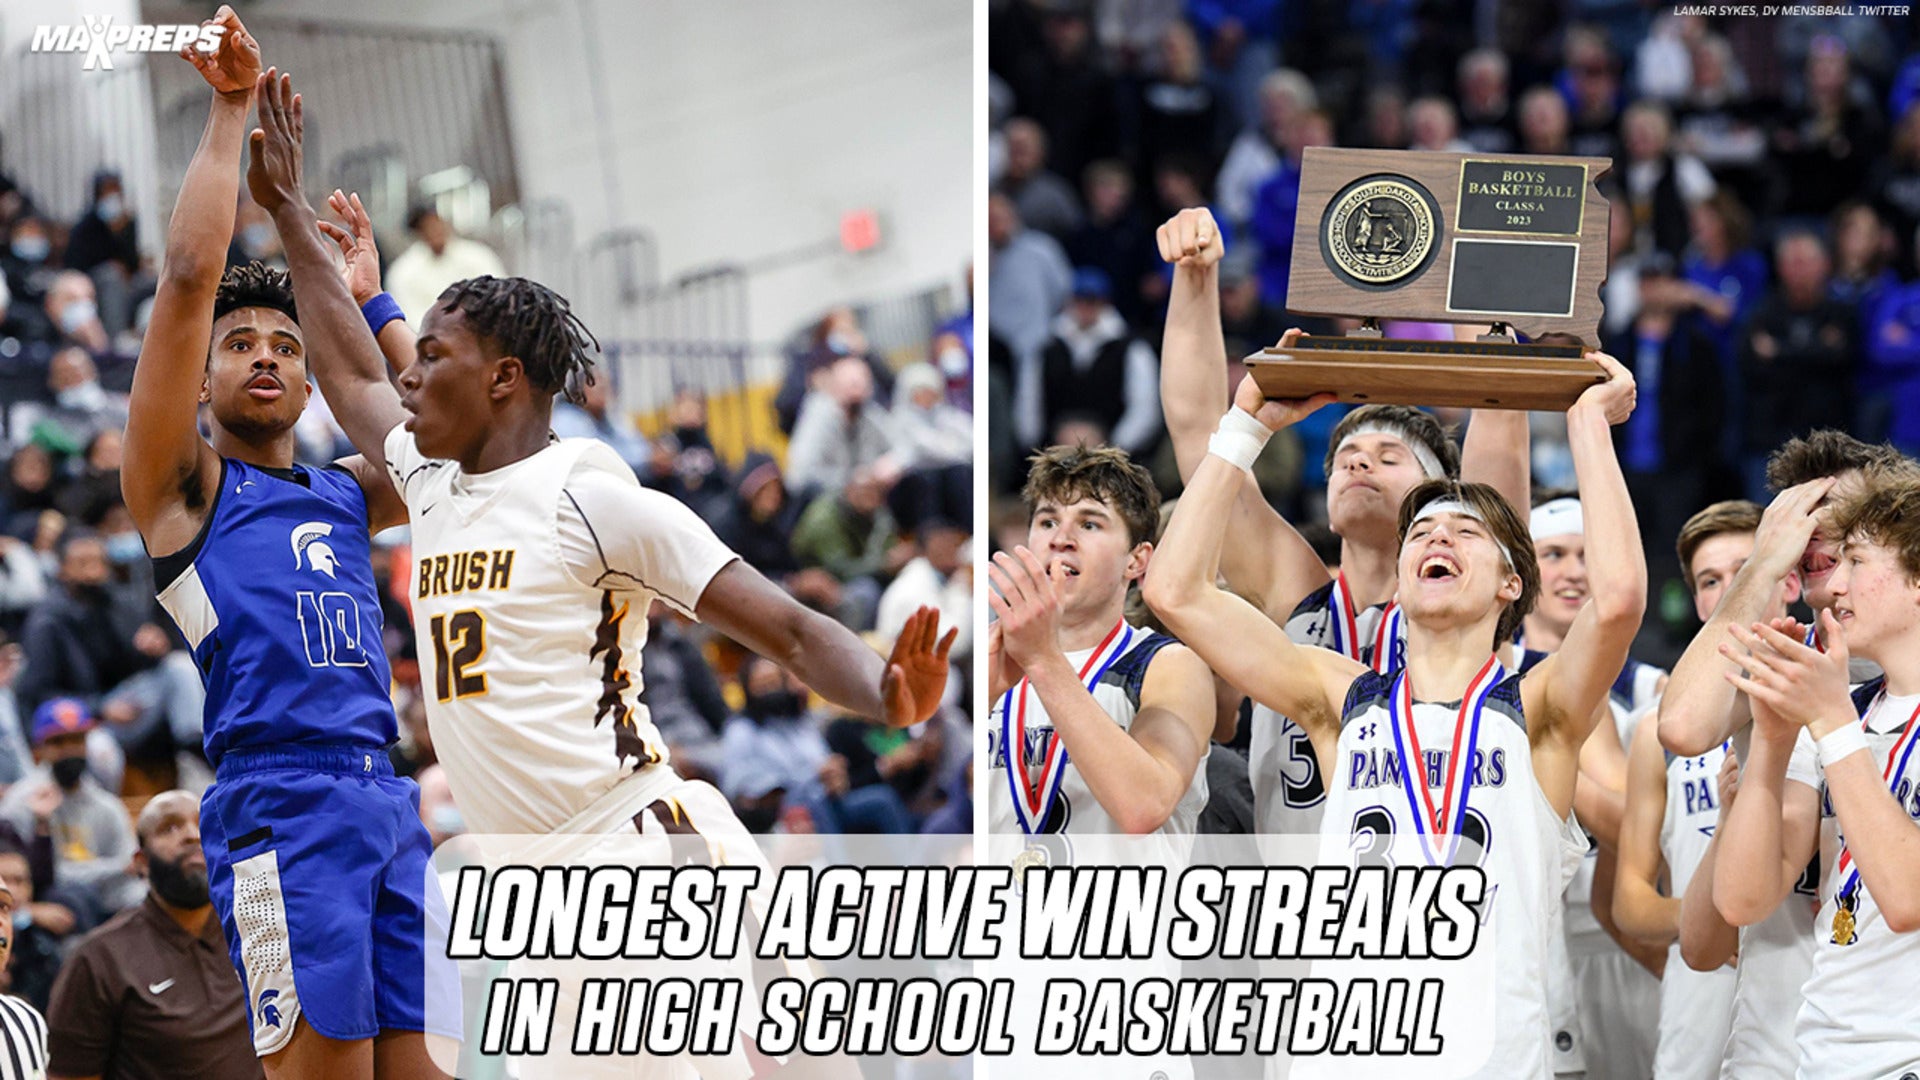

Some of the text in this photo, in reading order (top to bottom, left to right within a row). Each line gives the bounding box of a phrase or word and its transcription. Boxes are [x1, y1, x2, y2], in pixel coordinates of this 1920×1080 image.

[1468, 182, 1576, 198] BASKETBALL
[1502, 170, 1546, 183] BOYS
[1348, 186, 1420, 209] SOUTH DAKOTA
[1495, 200, 1545, 212] CLASS A
[1506, 215, 1531, 226] 2023
[1333, 234, 1354, 267] SCHOOL
[418, 549, 516, 600] BRUSH
[296, 591, 368, 667] 10
[430, 607, 489, 703] 12
[1348, 747, 1507, 790] PANHRS
